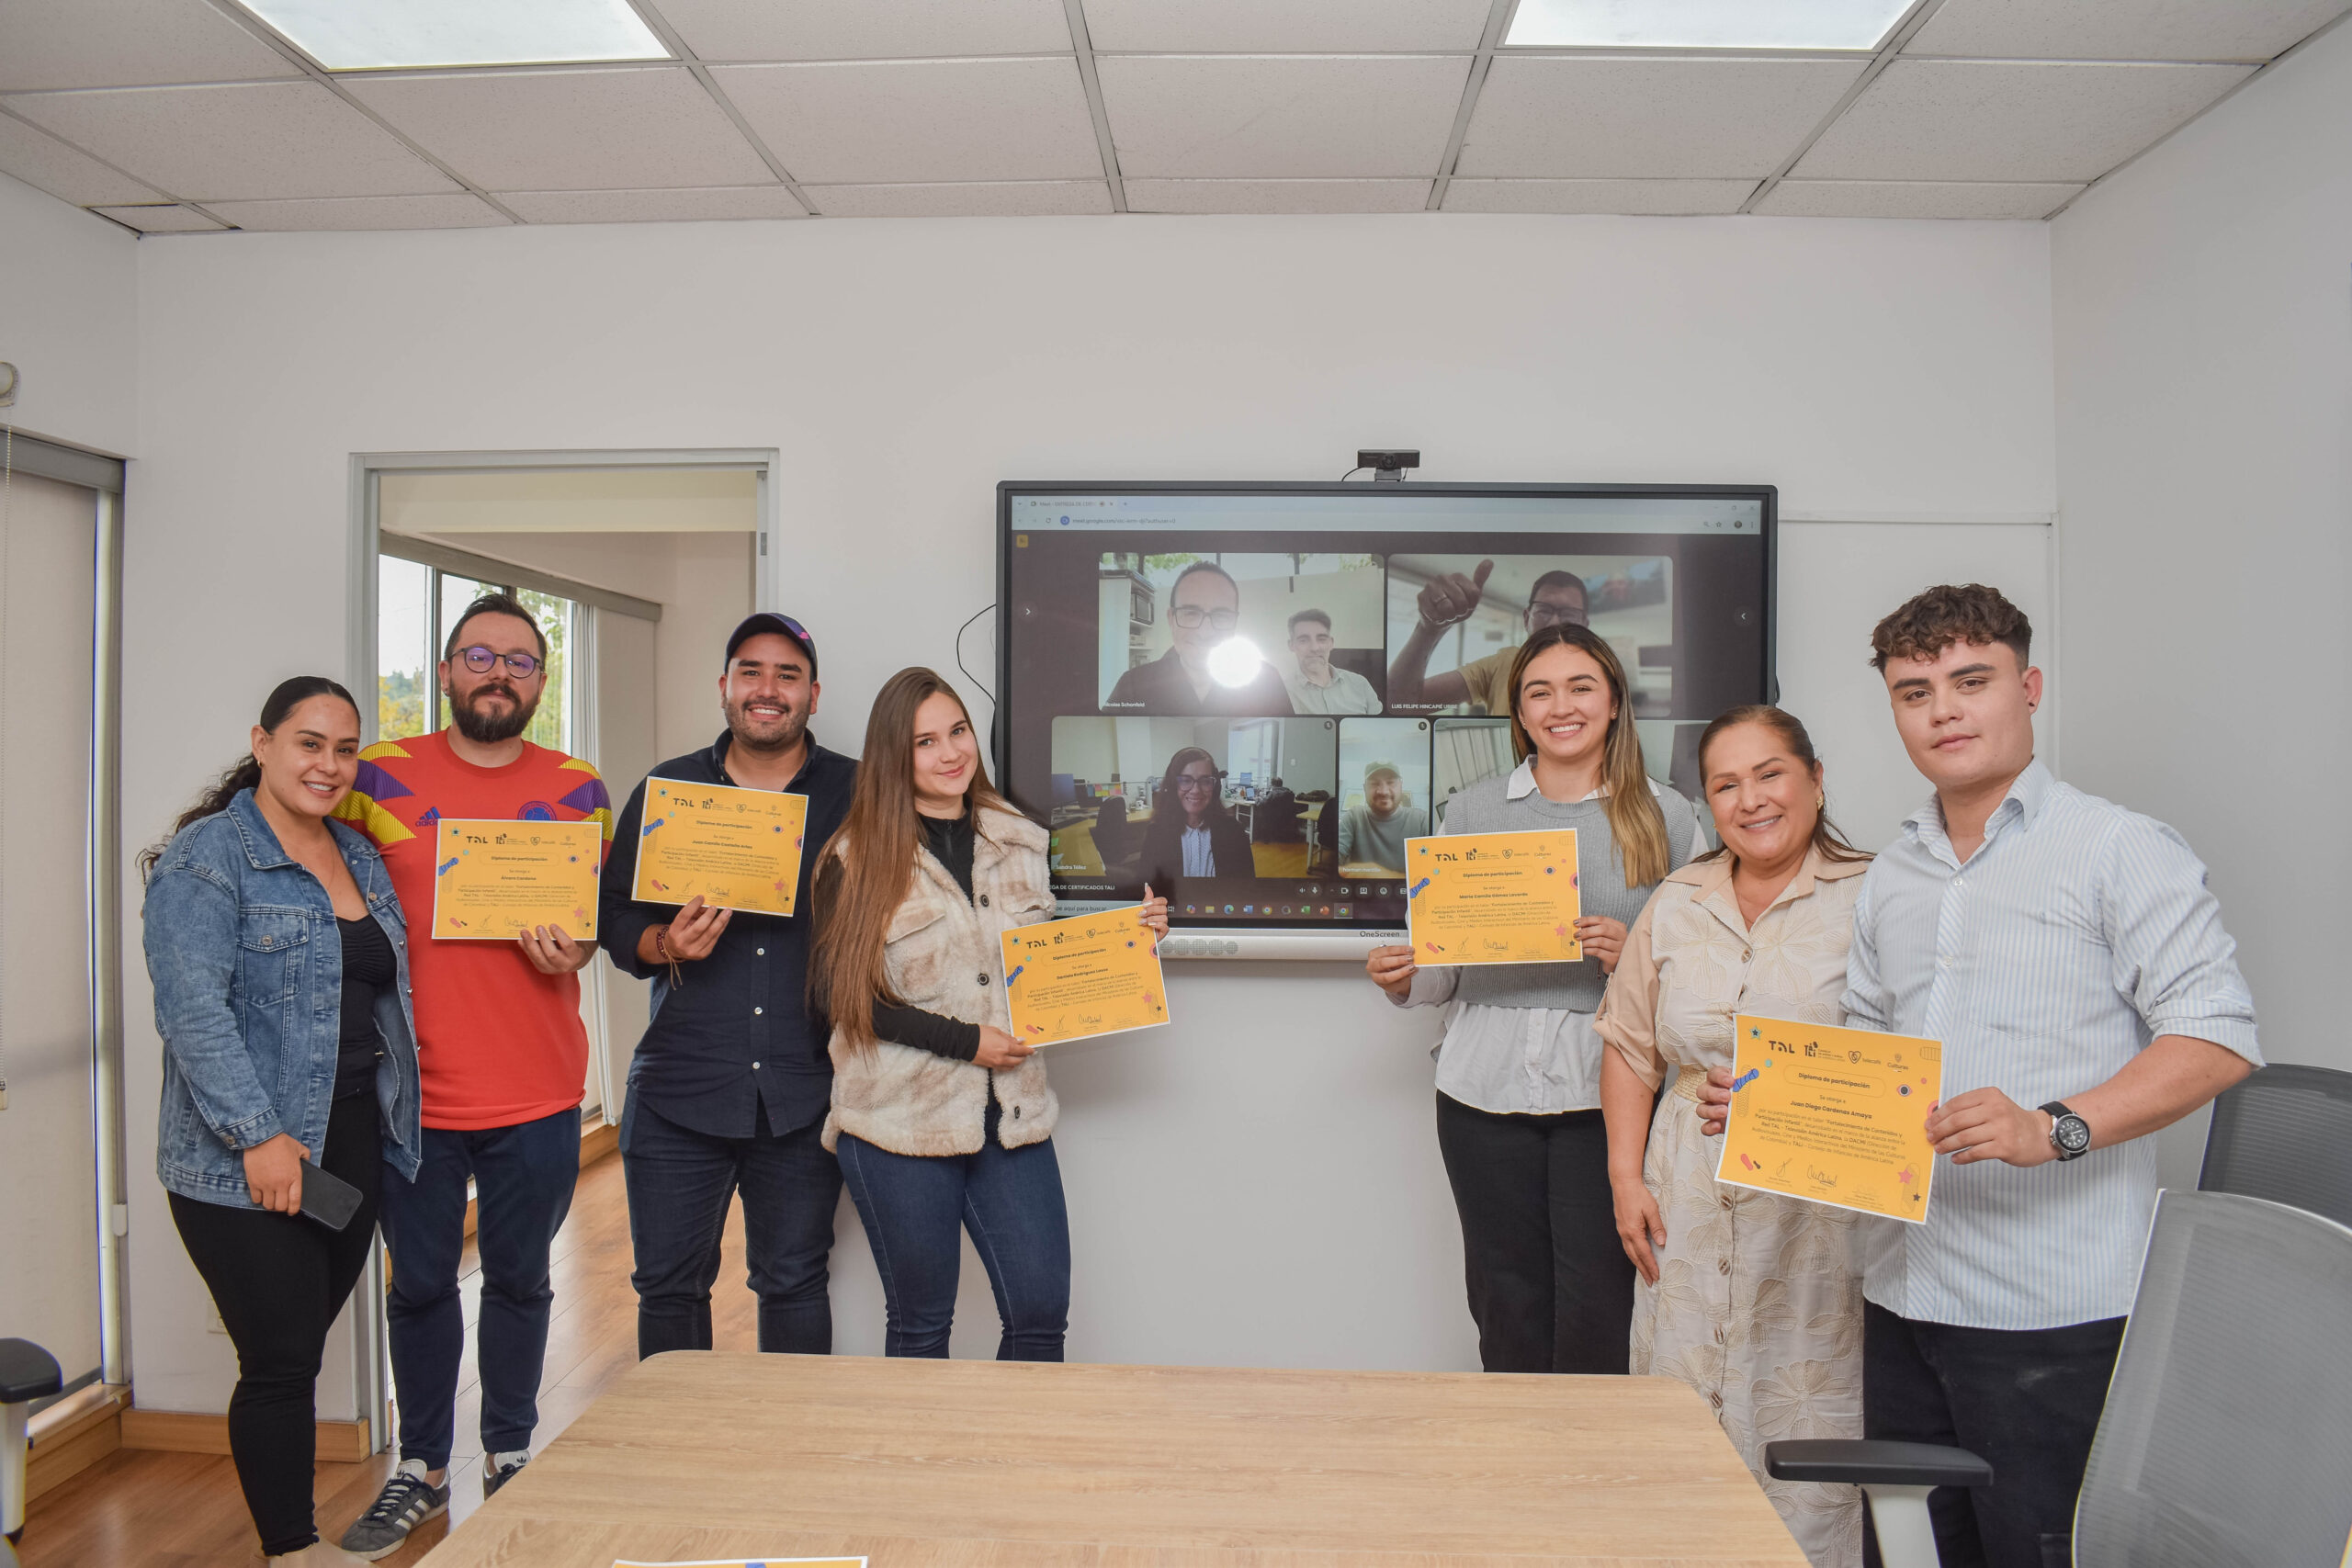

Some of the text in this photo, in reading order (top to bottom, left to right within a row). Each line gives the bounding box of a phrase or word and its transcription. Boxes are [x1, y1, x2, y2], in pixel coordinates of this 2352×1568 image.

[1064, 905, 1076, 913] aquí
[1078, 947, 1106, 957] participación
[1887, 1062, 1909, 1070] Culturas
[1798, 1072, 1823, 1082] Diploma
[1830, 1077, 1871, 1089] participación
[1805, 1102, 1821, 1111] Diego
[1822, 1106, 1849, 1115] Cardenas
[1850, 1111, 1872, 1121] Amaya
